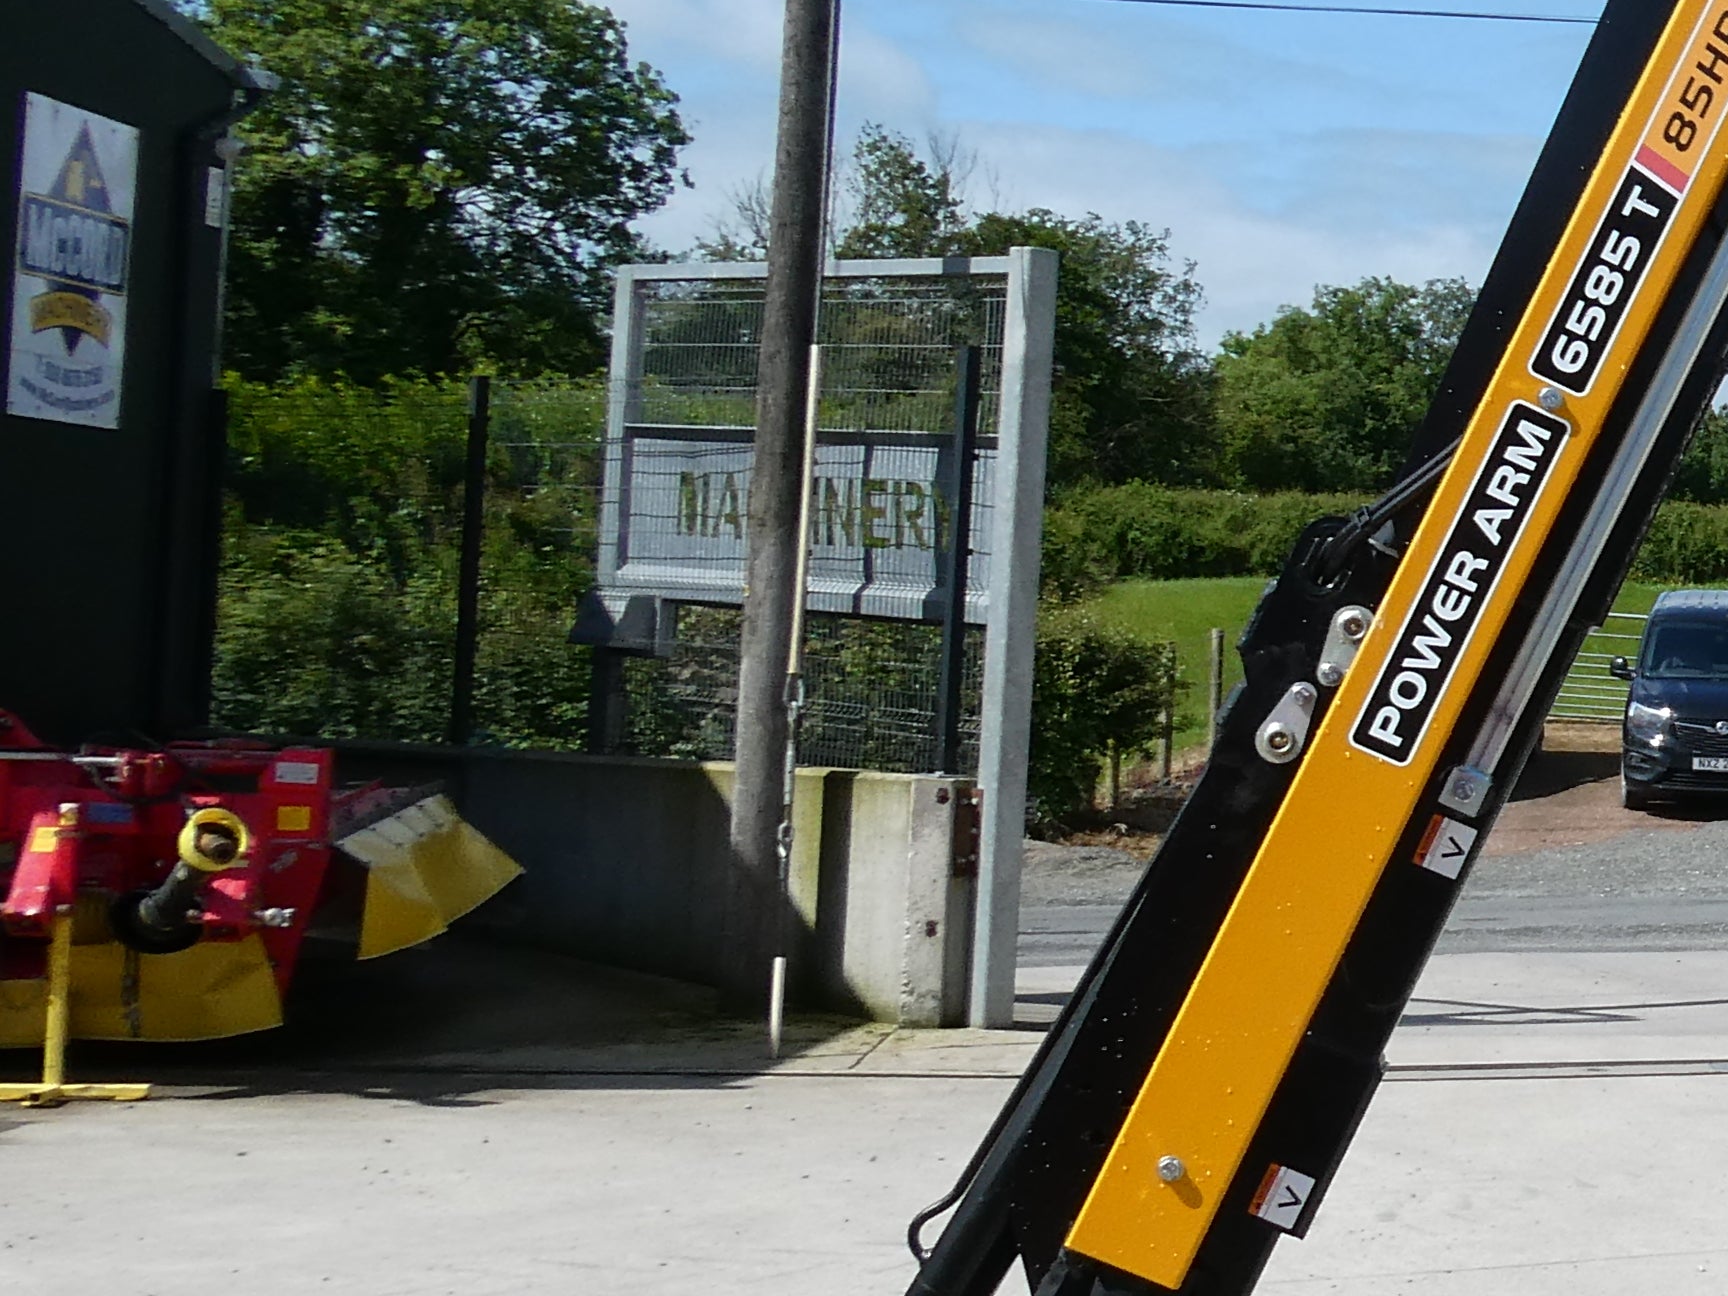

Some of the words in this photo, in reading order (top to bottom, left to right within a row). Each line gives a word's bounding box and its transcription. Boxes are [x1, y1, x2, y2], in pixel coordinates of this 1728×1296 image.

[1551, 230, 1642, 374] 6585
[1621, 185, 1660, 219] T
[677, 471, 956, 552] MAINERY
[1368, 550, 1489, 747] POWER
[1473, 419, 1552, 545] ARM
